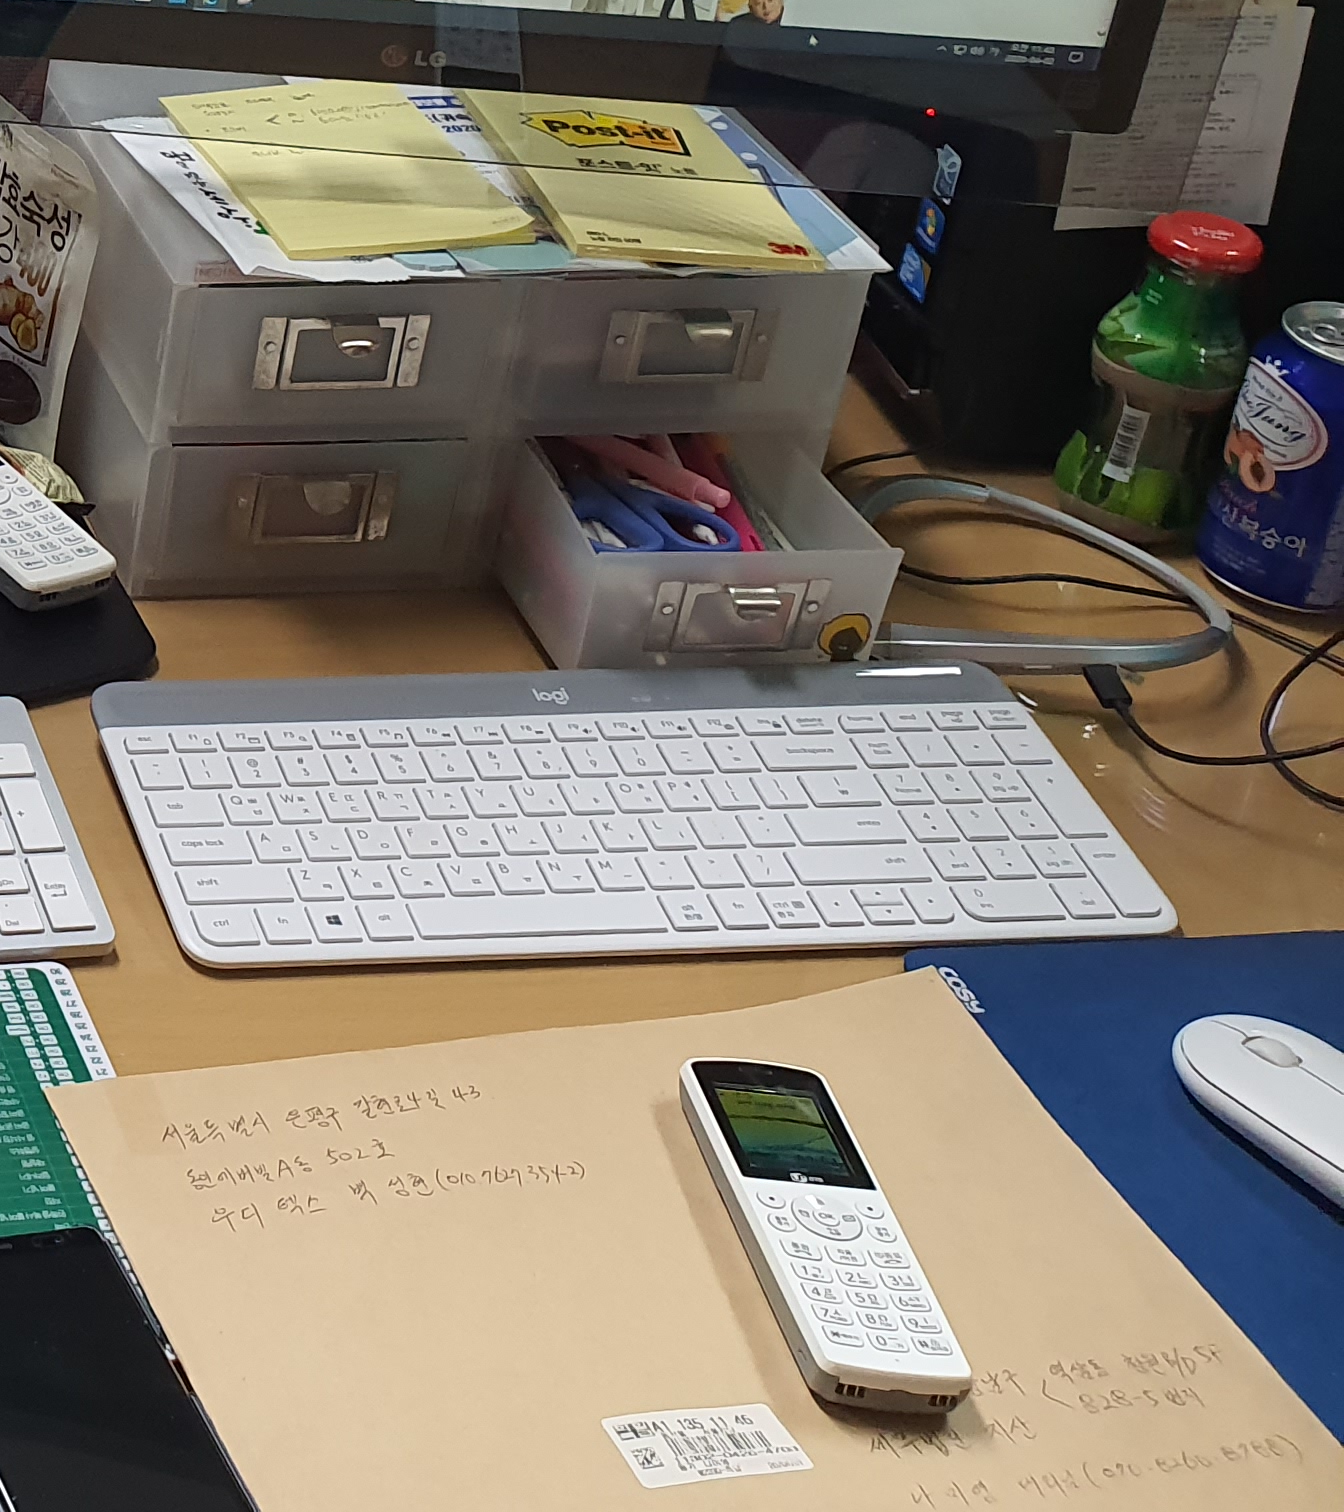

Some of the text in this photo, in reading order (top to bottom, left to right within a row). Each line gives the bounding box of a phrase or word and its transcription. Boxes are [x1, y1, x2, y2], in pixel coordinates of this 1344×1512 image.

[413, 48, 448, 68] LG
[542, 118, 676, 147] Post-it
[768, 241, 810, 257] 3M
[532, 687, 570, 705] logi
[162, 1111, 272, 1150] 서울특별시
[677, 1417, 705, 1432] 135
[735, 1414, 754, 1426] 46
